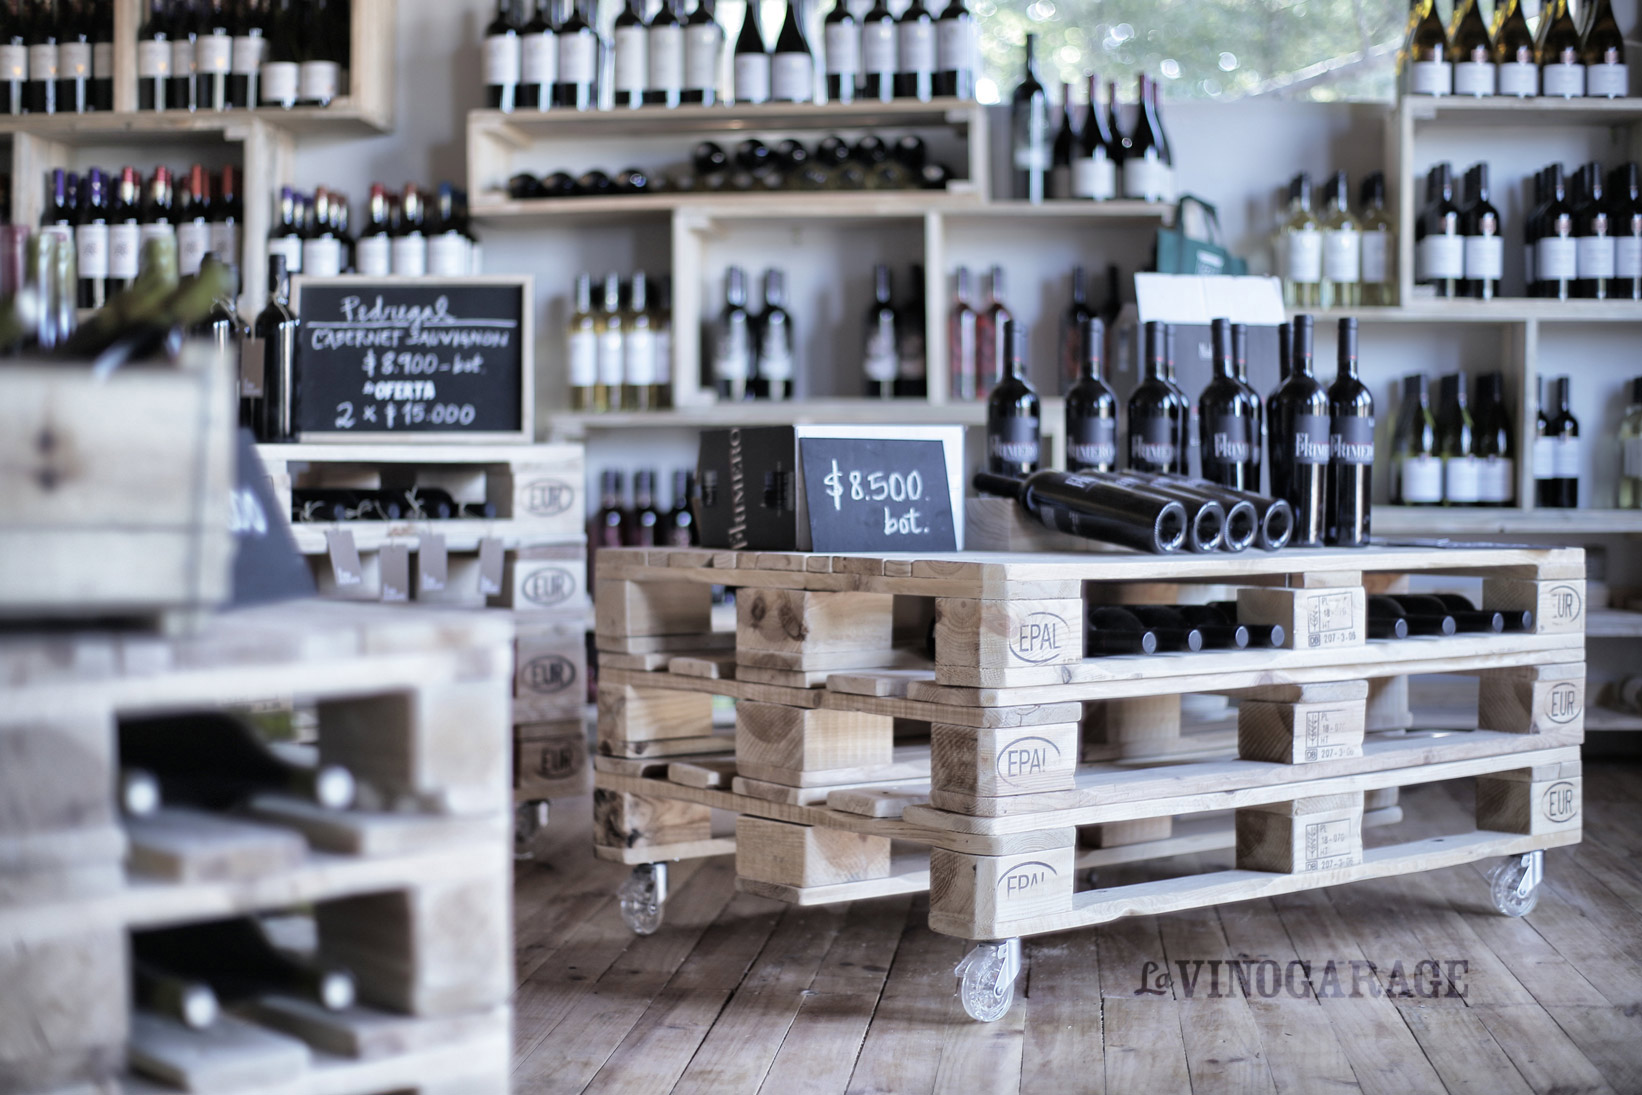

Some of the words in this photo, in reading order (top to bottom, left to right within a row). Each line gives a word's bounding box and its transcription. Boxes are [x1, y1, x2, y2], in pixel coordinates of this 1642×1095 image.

[374, 380, 437, 401] OFERTA
[334, 401, 356, 429] 2
[529, 485, 563, 511] EUR
[823, 458, 844, 511] $
[884, 506, 929, 535] bot.
[532, 574, 565, 601] EUR
[1019, 623, 1062, 652] EPAL
[531, 662, 565, 689] EUR
[1551, 690, 1575, 717] EUR
[1550, 787, 1573, 816] EUR
